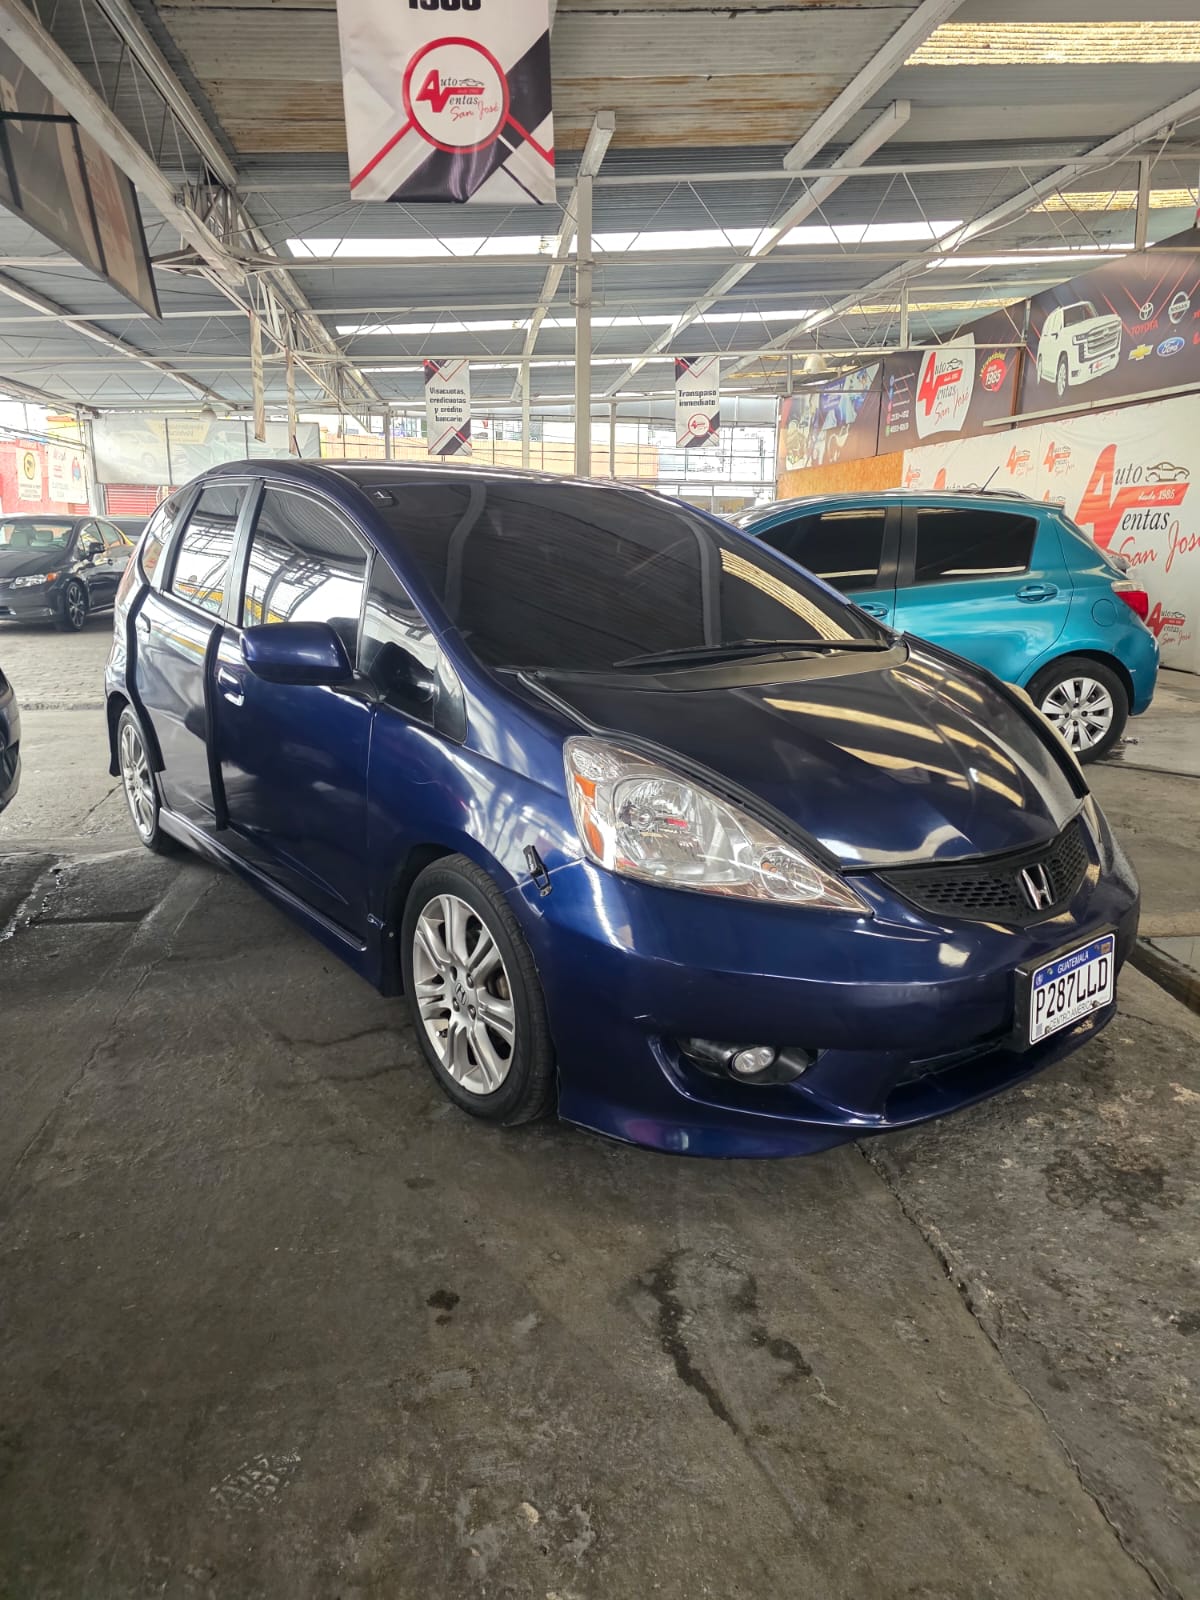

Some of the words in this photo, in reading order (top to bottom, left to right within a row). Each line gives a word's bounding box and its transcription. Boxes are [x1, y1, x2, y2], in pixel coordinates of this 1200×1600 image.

[416, 69, 458, 101] Auto
[450, 105, 474, 121] San
[1129, 320, 1158, 336] TOYOTA
[678, 389, 717, 399] Transpaso
[1164, 519, 1200, 573] Jos
[1057, 951, 1089, 974] GUATEMALA
[1036, 957, 1109, 1024] P287LLD
